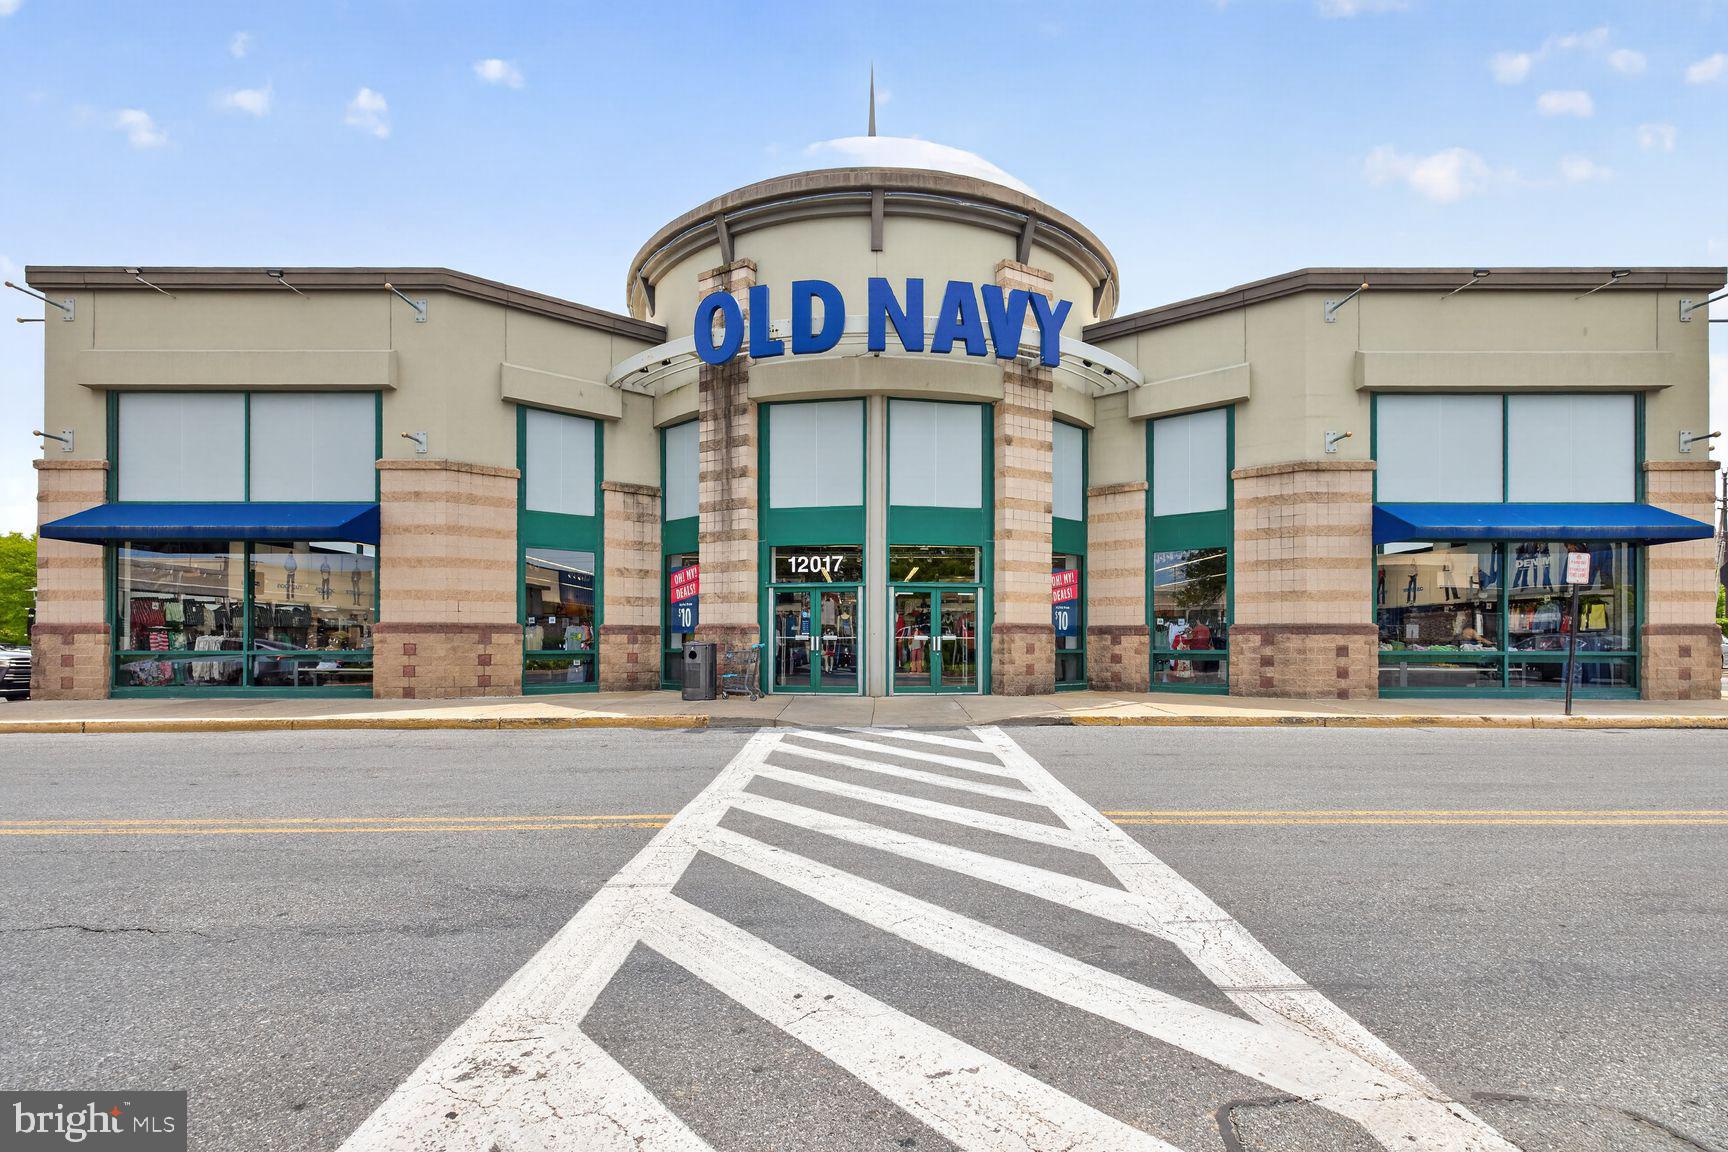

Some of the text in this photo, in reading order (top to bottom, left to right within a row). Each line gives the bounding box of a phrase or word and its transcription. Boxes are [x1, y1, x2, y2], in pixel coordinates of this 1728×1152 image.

[694, 277, 1073, 368] OLD NAVY
[788, 555, 844, 573] 12017
[674, 567, 698, 585] OH! MY!
[1052, 571, 1075, 587] OH! MY!
[676, 583, 696, 600] DEALS!
[1053, 587, 1073, 602] DEALS!
[678, 608, 691, 628] $10
[1055, 611, 1069, 631] $10
